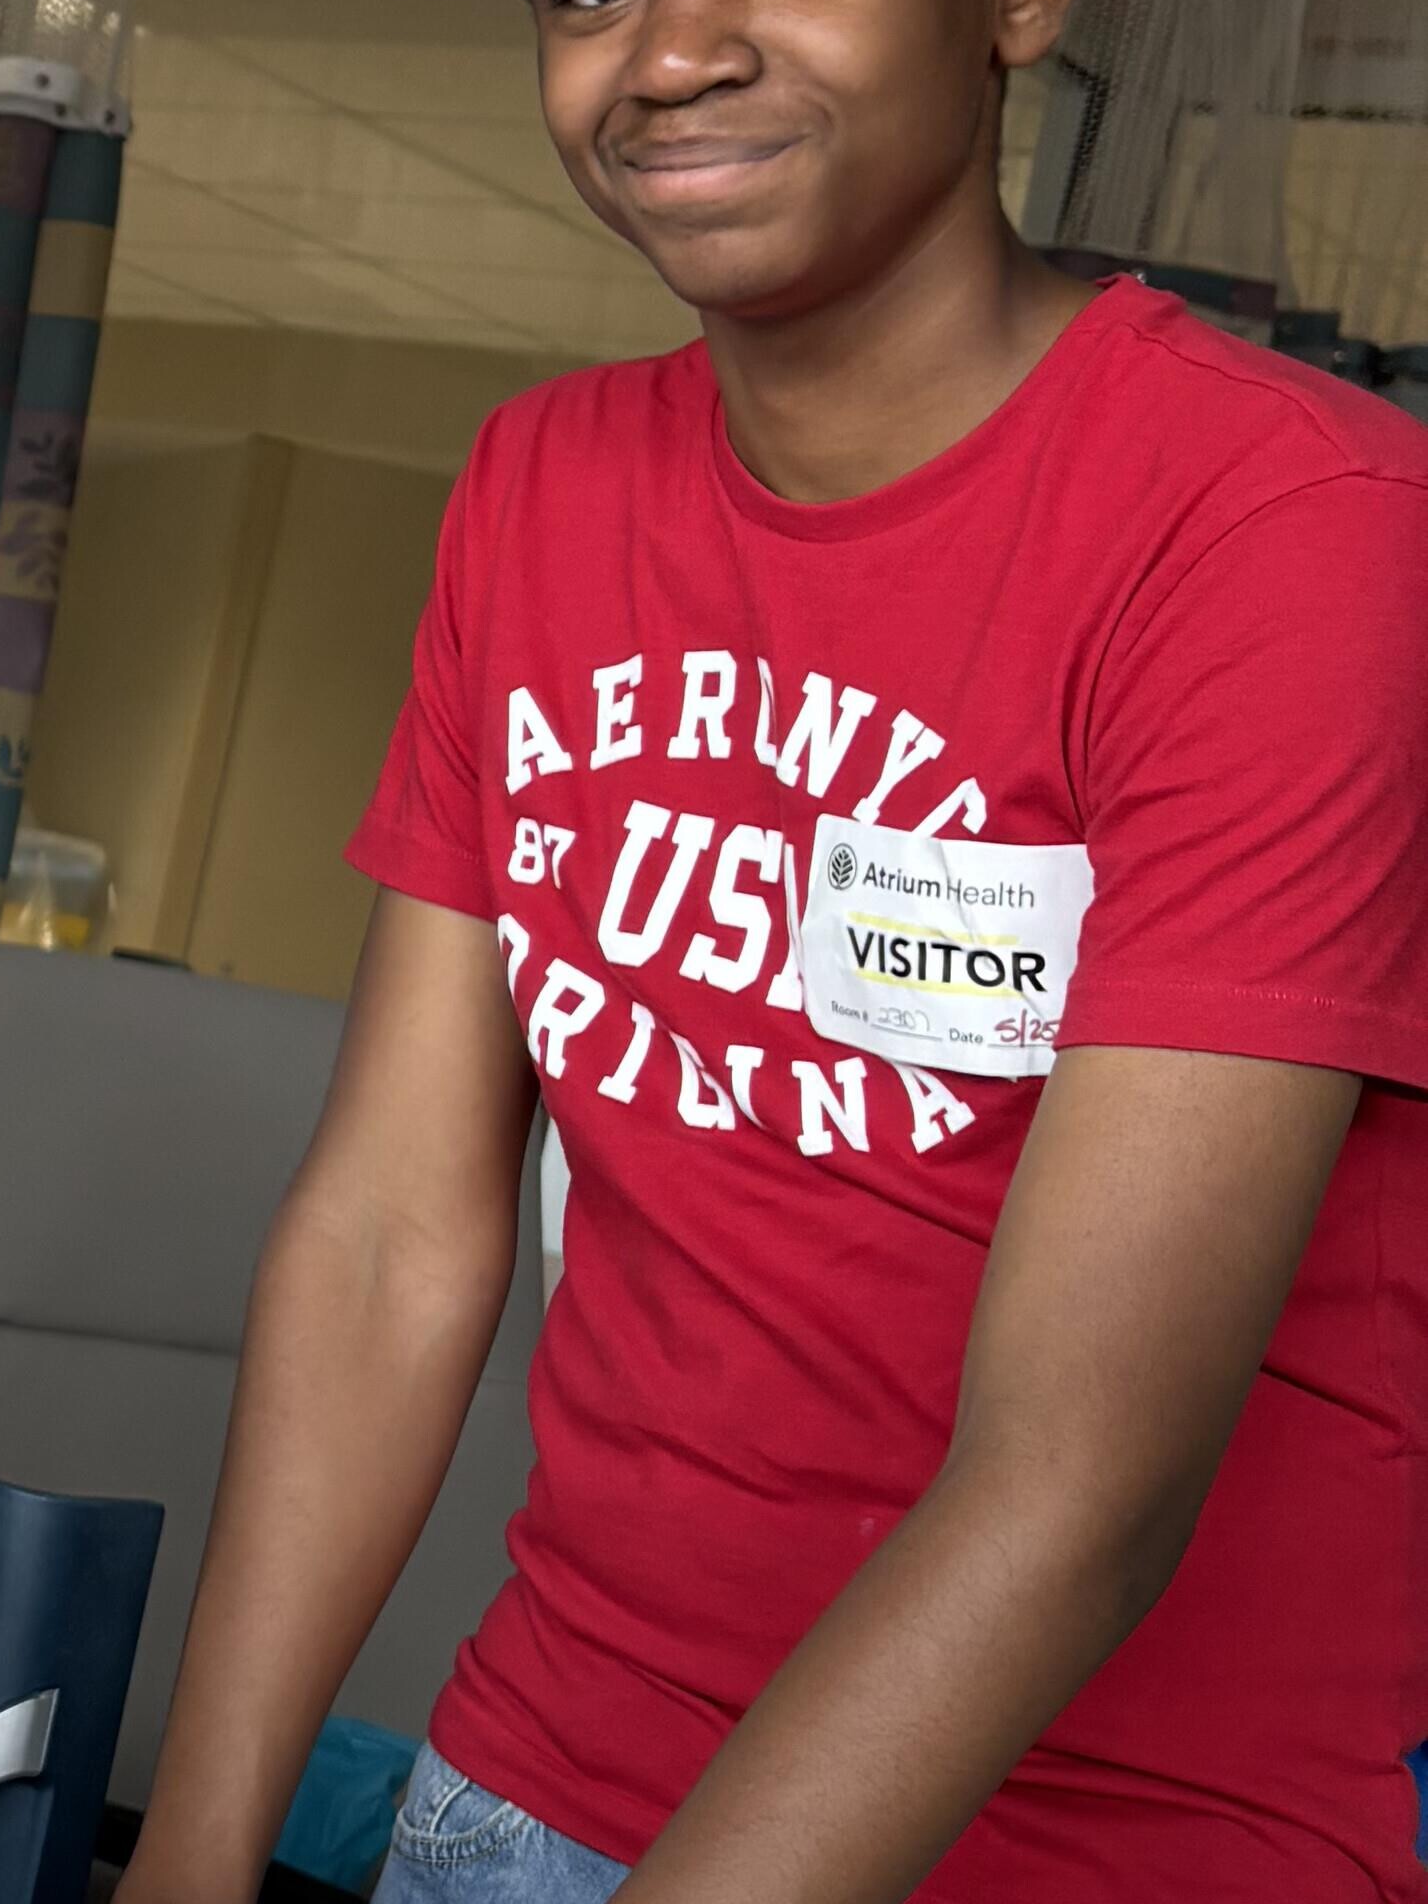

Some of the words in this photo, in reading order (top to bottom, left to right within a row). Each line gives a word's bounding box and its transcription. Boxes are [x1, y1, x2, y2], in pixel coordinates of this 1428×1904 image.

[507, 816, 576, 891] 87
[597, 799, 804, 1013] US
[862, 861, 941, 898] Atrium
[946, 876, 1035, 908] Health
[846, 925, 1048, 993] VISITOR
[831, 1000, 860, 1020] Room
[949, 1027, 984, 1045] Date
